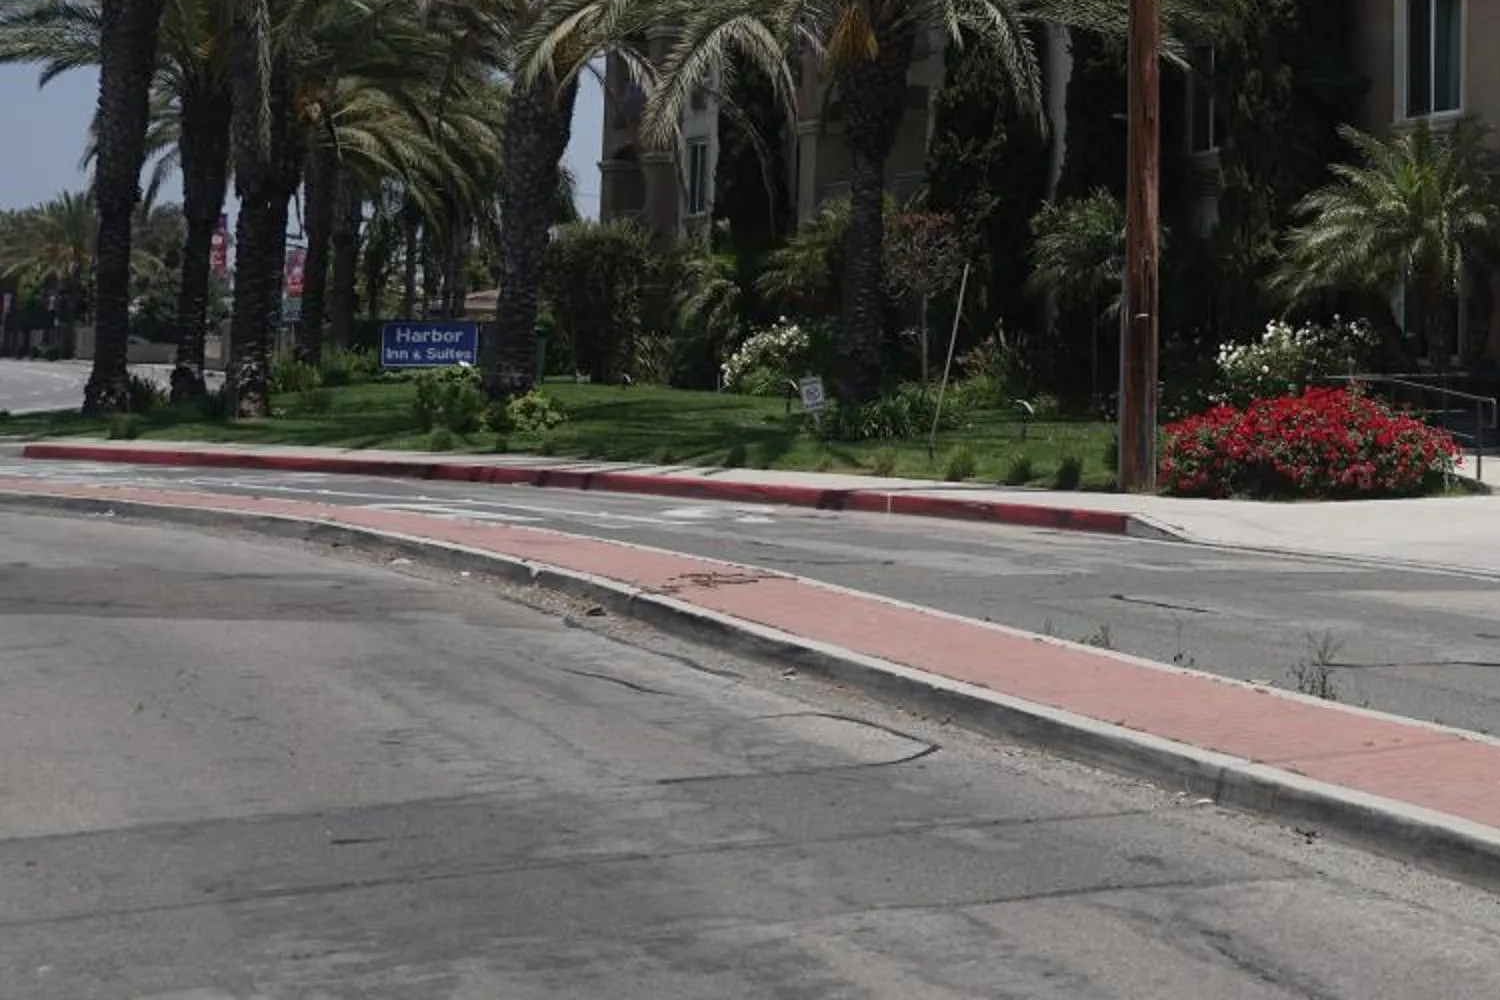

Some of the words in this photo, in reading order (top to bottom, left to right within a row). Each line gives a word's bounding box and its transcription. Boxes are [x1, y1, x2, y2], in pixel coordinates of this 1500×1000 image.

[396, 327, 464, 343] Harbor
[385, 347, 409, 360] Inn
[413, 349, 422, 360] &
[426, 347, 472, 360] Suites
